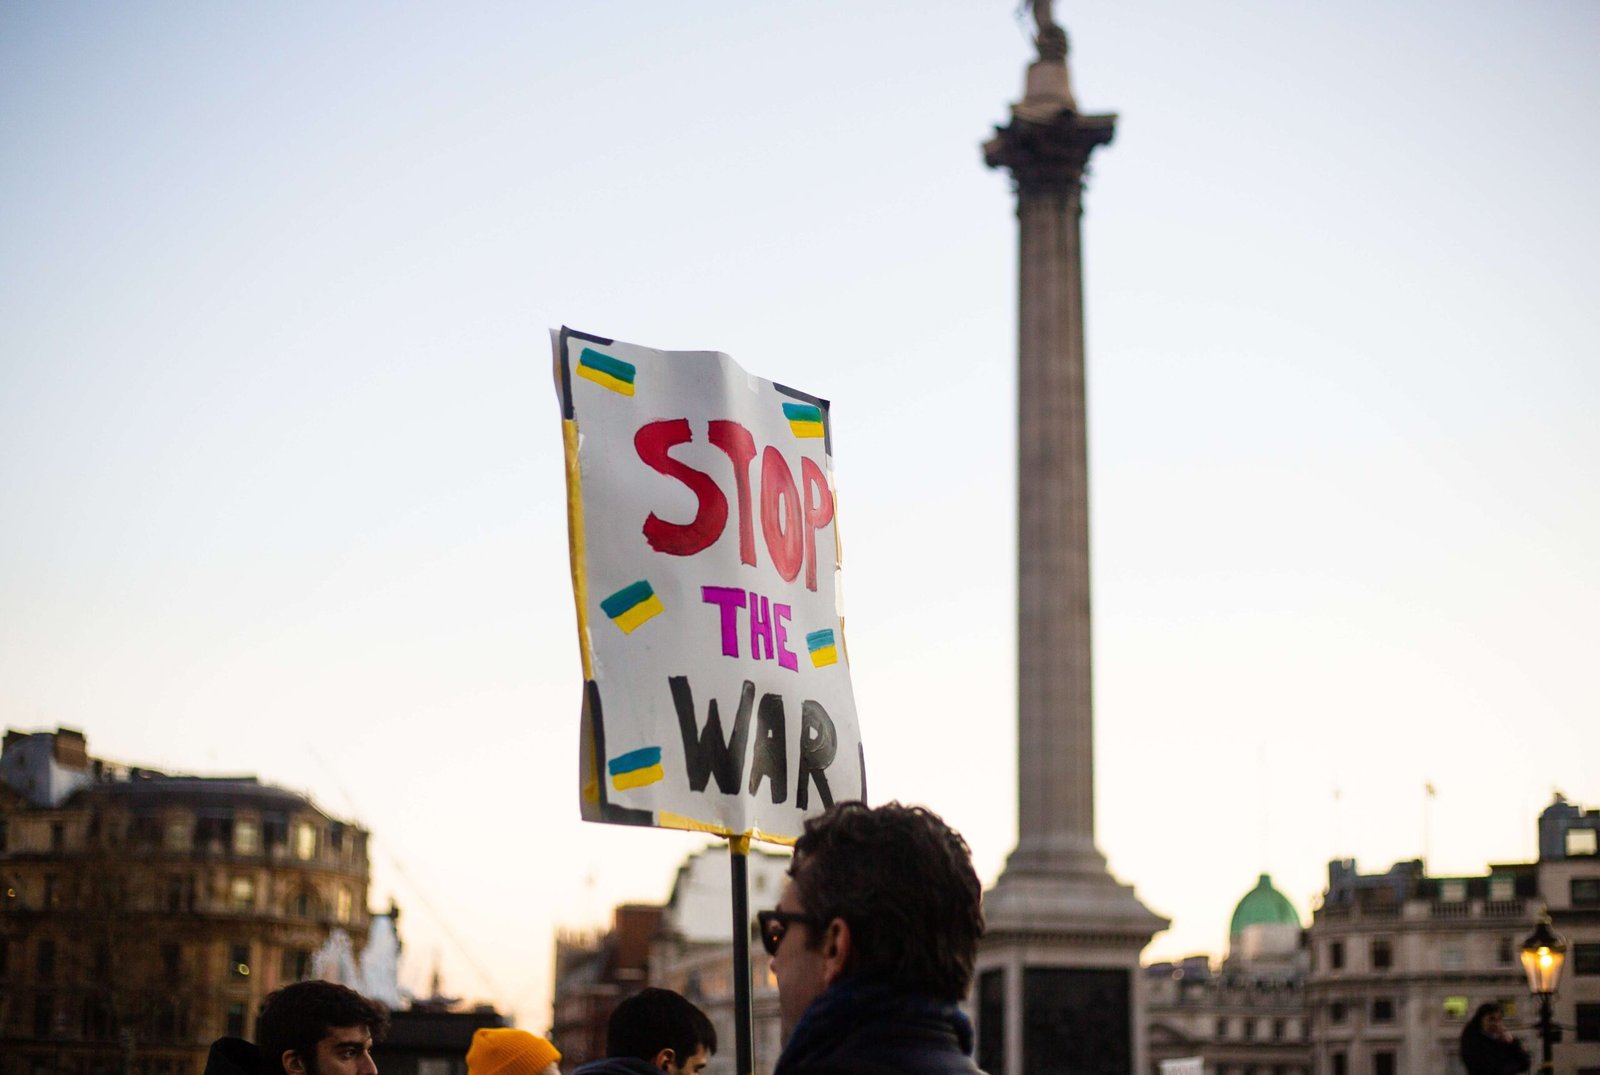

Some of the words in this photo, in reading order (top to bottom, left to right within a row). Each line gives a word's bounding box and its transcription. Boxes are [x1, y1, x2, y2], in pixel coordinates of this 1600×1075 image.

[634, 417, 833, 592] STOP
[701, 585, 798, 672] THE
[668, 675, 837, 811] WAR
